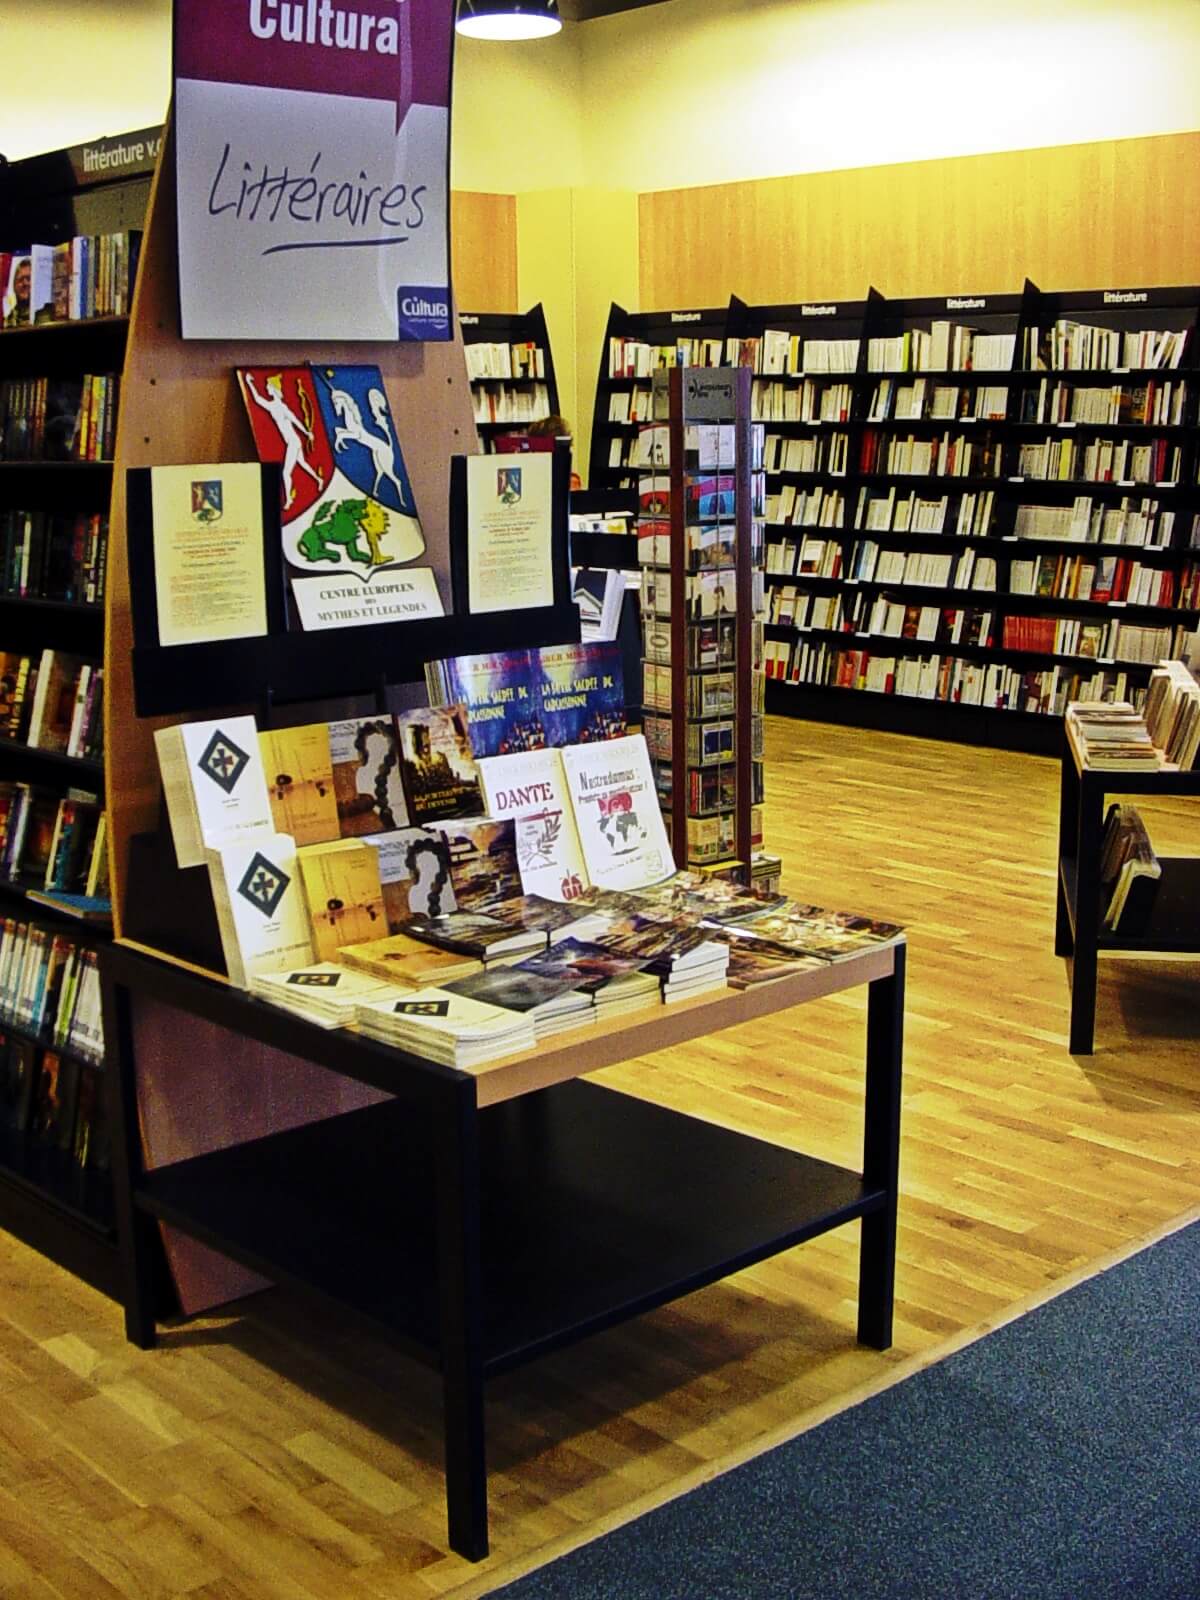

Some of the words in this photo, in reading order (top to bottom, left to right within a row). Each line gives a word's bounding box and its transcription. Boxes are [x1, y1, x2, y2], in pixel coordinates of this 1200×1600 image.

[249, 0, 399, 55] Cultura
[83, 143, 144, 172] littérature
[208, 143, 427, 230] Littéraires
[319, 588, 360, 601] CENTRE
[317, 607, 360, 622] MYTHES
[361, 607, 374, 617] ET
[495, 782, 555, 812] DANTE
